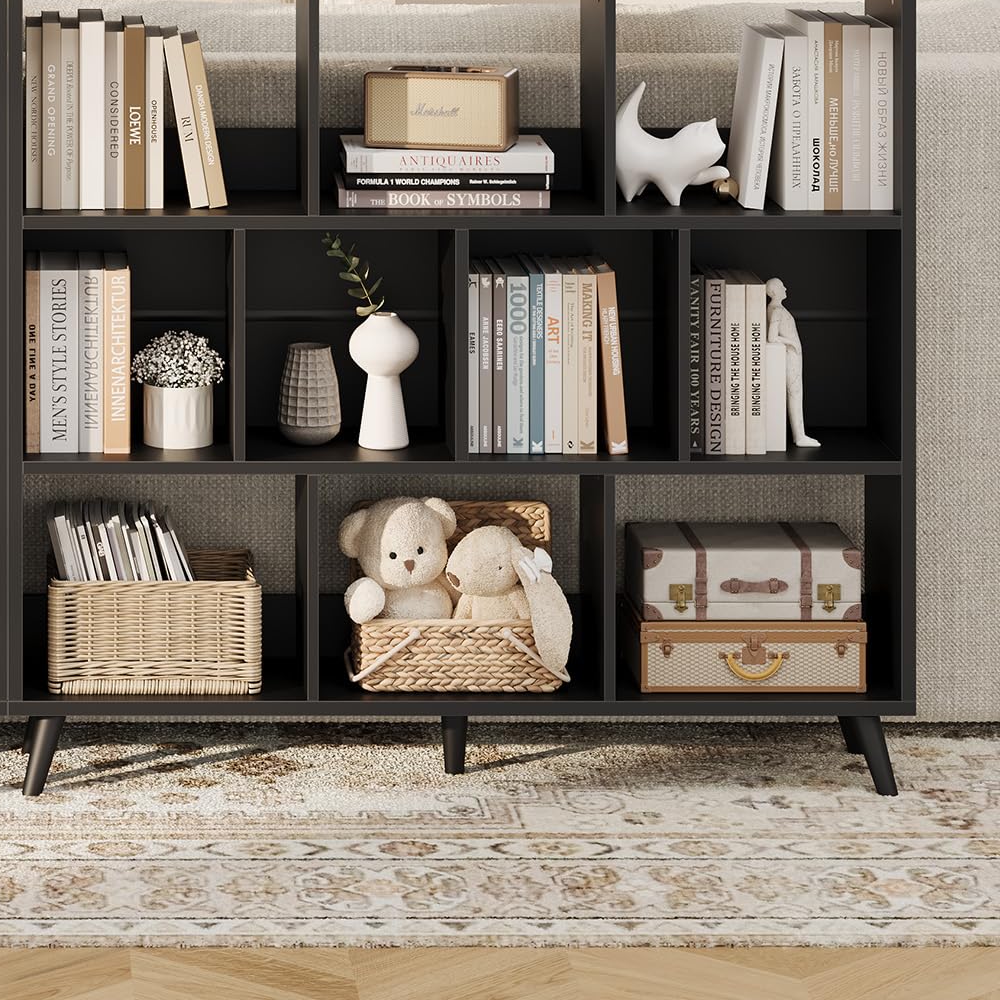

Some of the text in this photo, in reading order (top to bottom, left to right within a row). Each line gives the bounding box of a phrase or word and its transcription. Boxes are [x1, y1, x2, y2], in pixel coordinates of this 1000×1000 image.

[48, 64, 56, 157] GRAND OPENING
[110, 81, 119, 159] CONSIDERED
[130, 106, 141, 145] LOEWE
[200, 110, 211, 140] MODERN
[792, 66, 801, 189] ЗАБОТА О ПРЕДАННЫХ
[877, 51, 888, 187] НОВЫЙ ОБРАЗ ЖИЗНИ
[205, 141, 215, 166] DESIGN
[399, 156, 501, 168] ANTIQUAIRES
[811, 138, 820, 192] ШОКОЛАД
[829, 158, 838, 193] ЛУЧШЕ
[356, 178, 388, 186] FORMULA
[390, 178, 394, 186] 1
[395, 178, 420, 186] WORLD
[421, 178, 460, 186] CHAMPIONS
[388, 193, 431, 206] BOOK
[446, 193, 521, 206] SYMBOLS
[510, 283, 527, 335] 1000
[547, 316, 559, 344] ART
[582, 283, 592, 327] MAKING
[52, 278, 67, 441] MEN'S STYLE STORIES
[111, 275, 125, 422] INNENARCHITEKTUR
[582, 330, 592, 342] IT
[608, 306, 620, 376] NEW URBAN HOUSING
[691, 278, 699, 434] VANITY FAIR 100 YEARS
[710, 283, 721, 453] FURNITURE DESIGN
[731, 322, 740, 417] BRINGING THE HOUSE HOME
[752, 322, 761, 417] BRINGING THE HOUSE HOME
